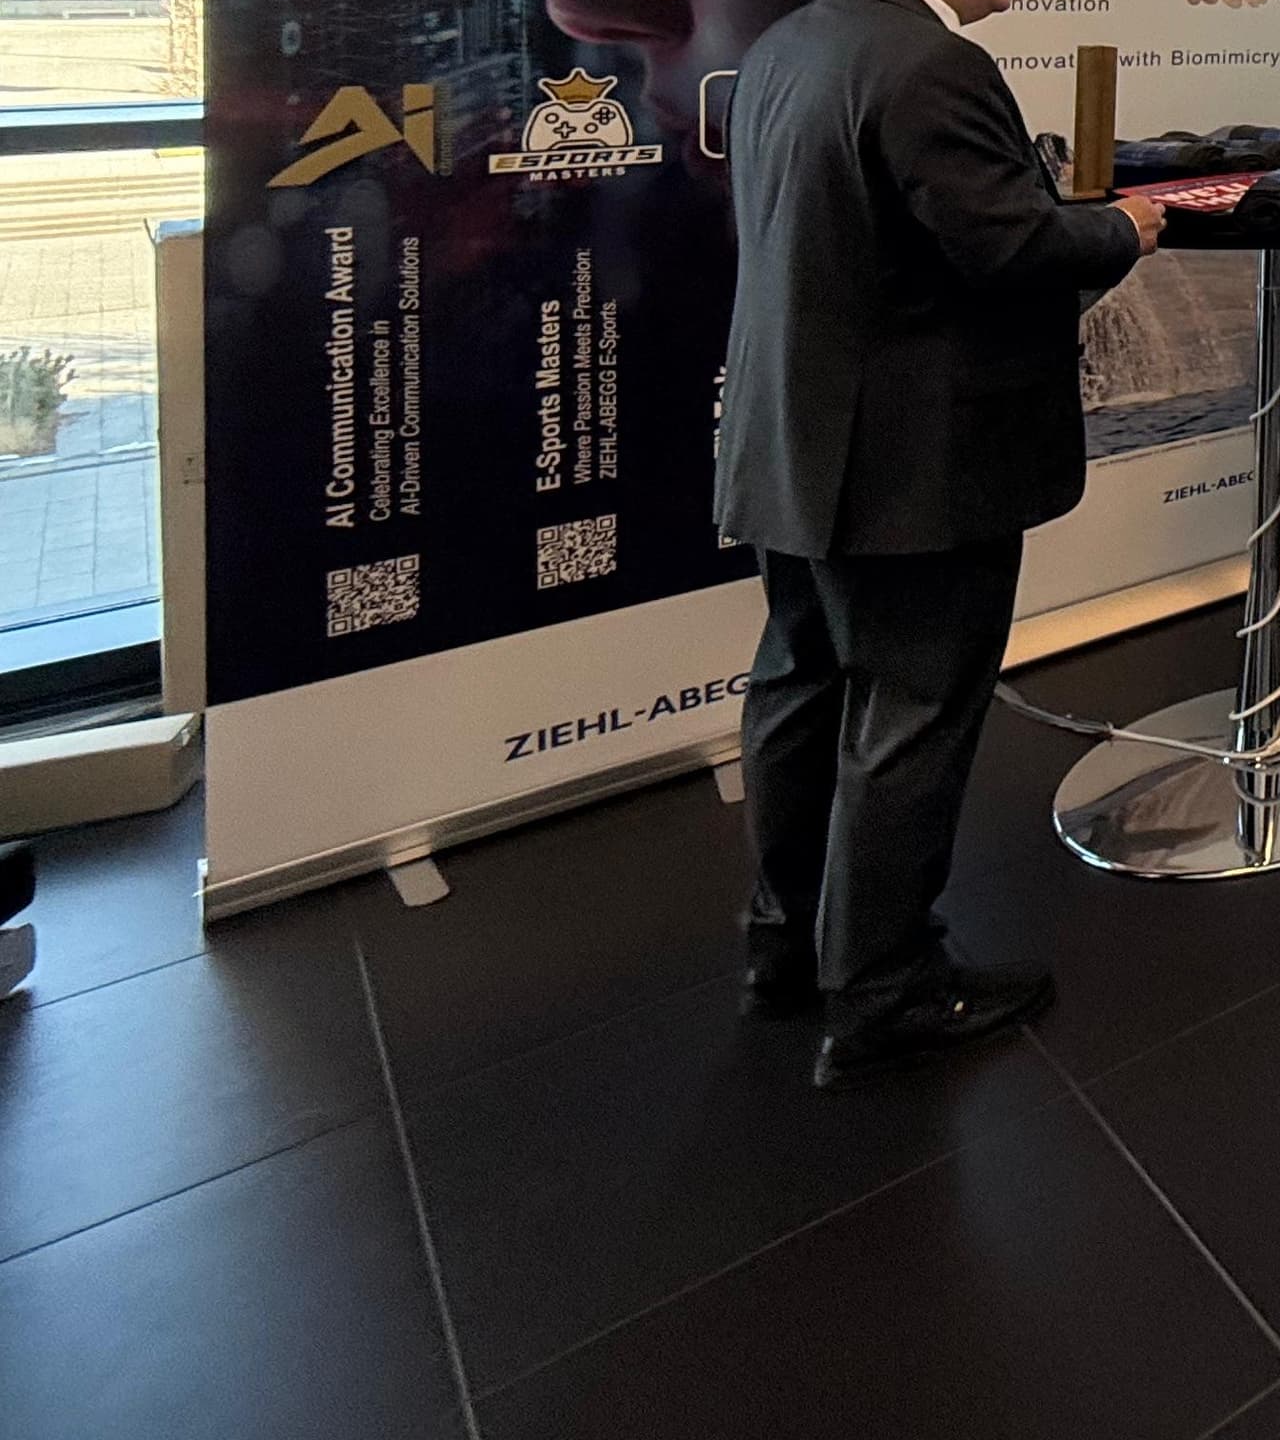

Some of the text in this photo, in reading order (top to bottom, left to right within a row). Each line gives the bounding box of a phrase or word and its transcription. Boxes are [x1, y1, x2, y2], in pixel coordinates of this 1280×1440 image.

[1118, 50, 1161, 67] with
[1170, 49, 1280, 68] Biomimicry
[493, 147, 660, 170] ESPORTS
[529, 166, 626, 182] MASTERS
[324, 226, 355, 529] AI Communication Award
[399, 236, 421, 516] AI-Driven Communication Solutions
[573, 321, 592, 370] Meets
[368, 319, 395, 522] Celebrating Excellence in
[535, 299, 568, 493] E-Sports Masters
[573, 371, 592, 432] Passion
[599, 369, 618, 479] ZIEHL-ABEGG
[574, 435, 592, 485] Where
[503, 671, 752, 763] ZIEHL-ABEG
